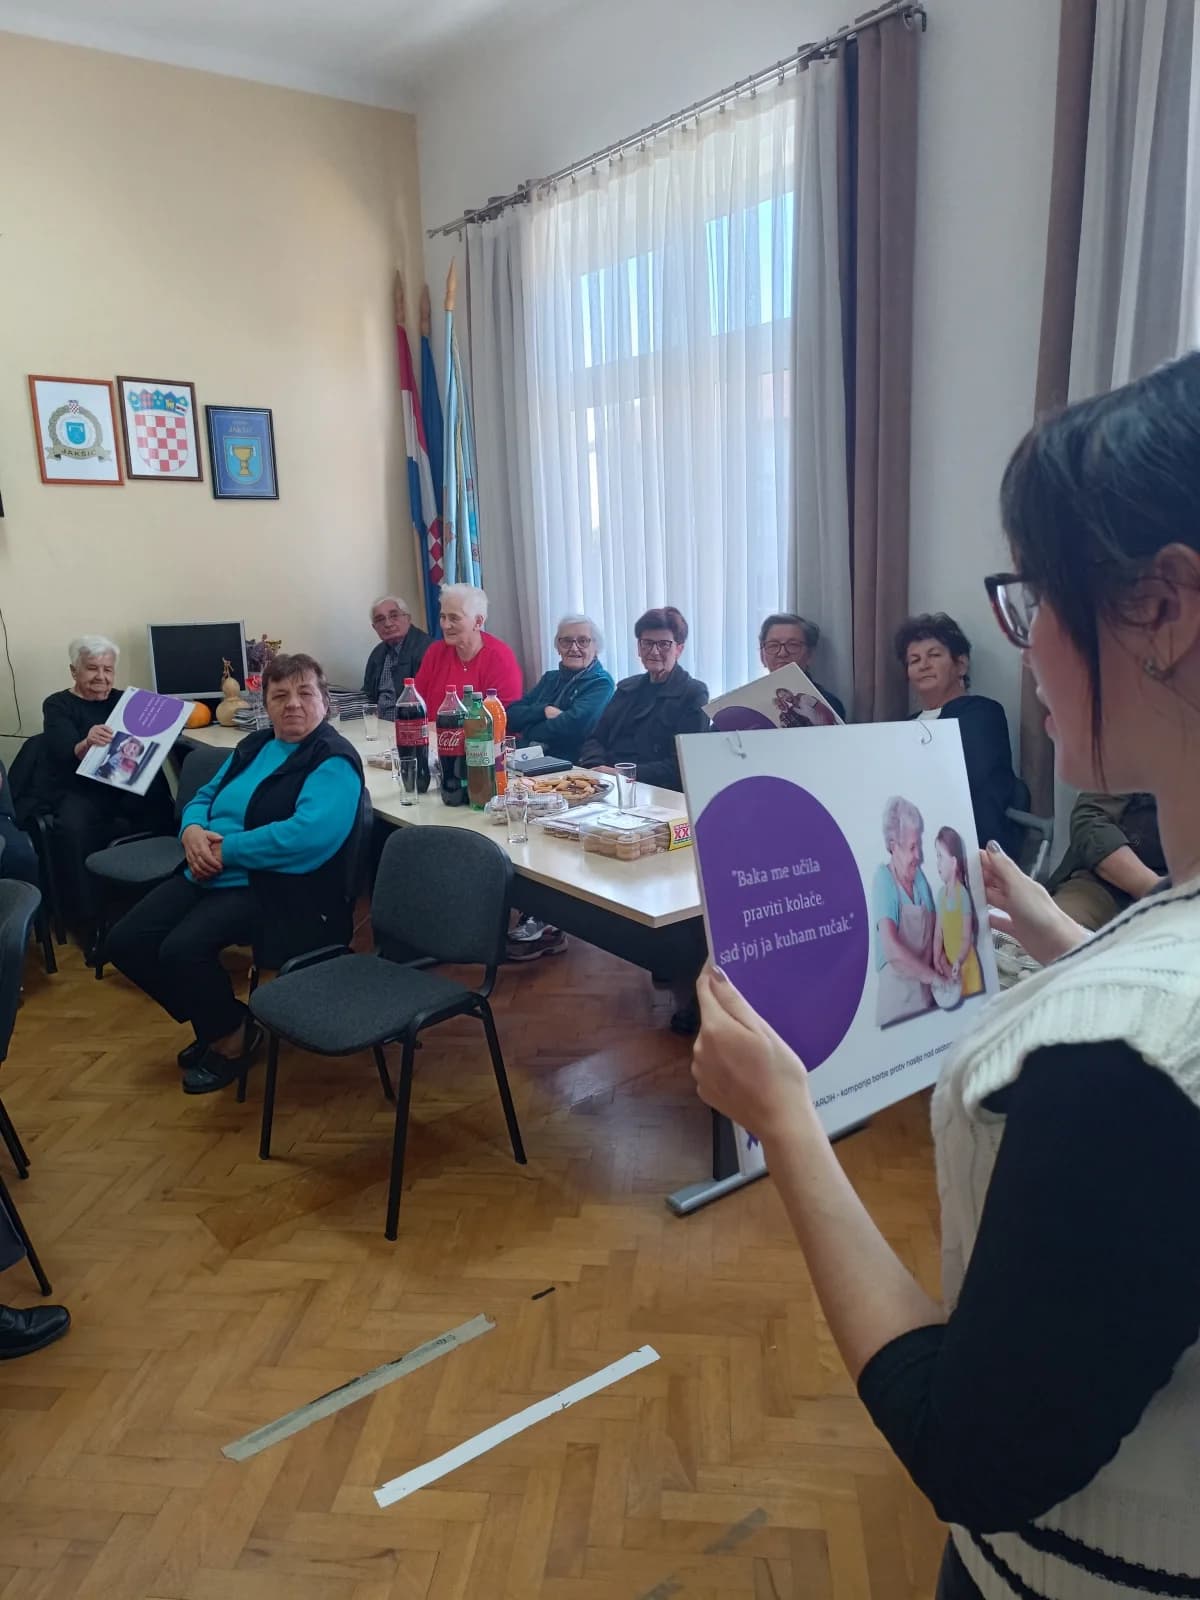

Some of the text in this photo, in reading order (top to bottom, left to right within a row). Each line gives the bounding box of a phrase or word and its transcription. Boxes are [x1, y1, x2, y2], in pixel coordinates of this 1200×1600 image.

[771, 866, 789, 880] me
[792, 857, 821, 876] učila
[743, 899, 783, 927] praviti
[720, 943, 740, 965] sad
[742, 939, 759, 962] joj
[761, 937, 773, 958] ja
[774, 928, 817, 949] kuham
[840, 1078, 871, 1097] kampanja
[871, 1070, 889, 1083] borbe
[890, 1063, 906, 1076] protiv
[906, 1054, 923, 1068] nasilja
